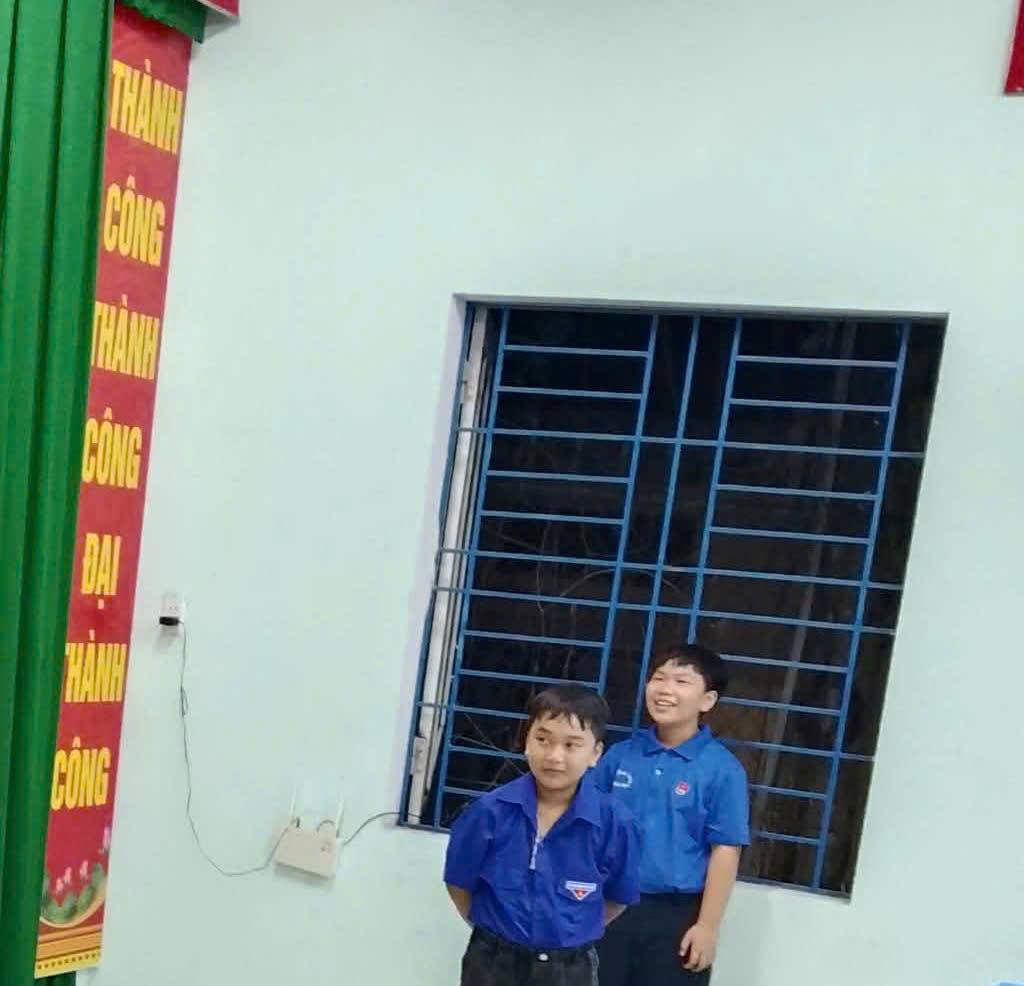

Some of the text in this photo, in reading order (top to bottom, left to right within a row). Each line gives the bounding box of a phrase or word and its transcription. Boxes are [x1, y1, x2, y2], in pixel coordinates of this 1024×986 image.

[110, 58, 184, 155] THÀNH
[103, 174, 166, 267] CÔNG
[81, 407, 143, 489] CÔNG
[81, 532, 122, 610] ĐẠI
[64, 629, 127, 704] HÀNH
[51, 736, 111, 811] CÔNG
